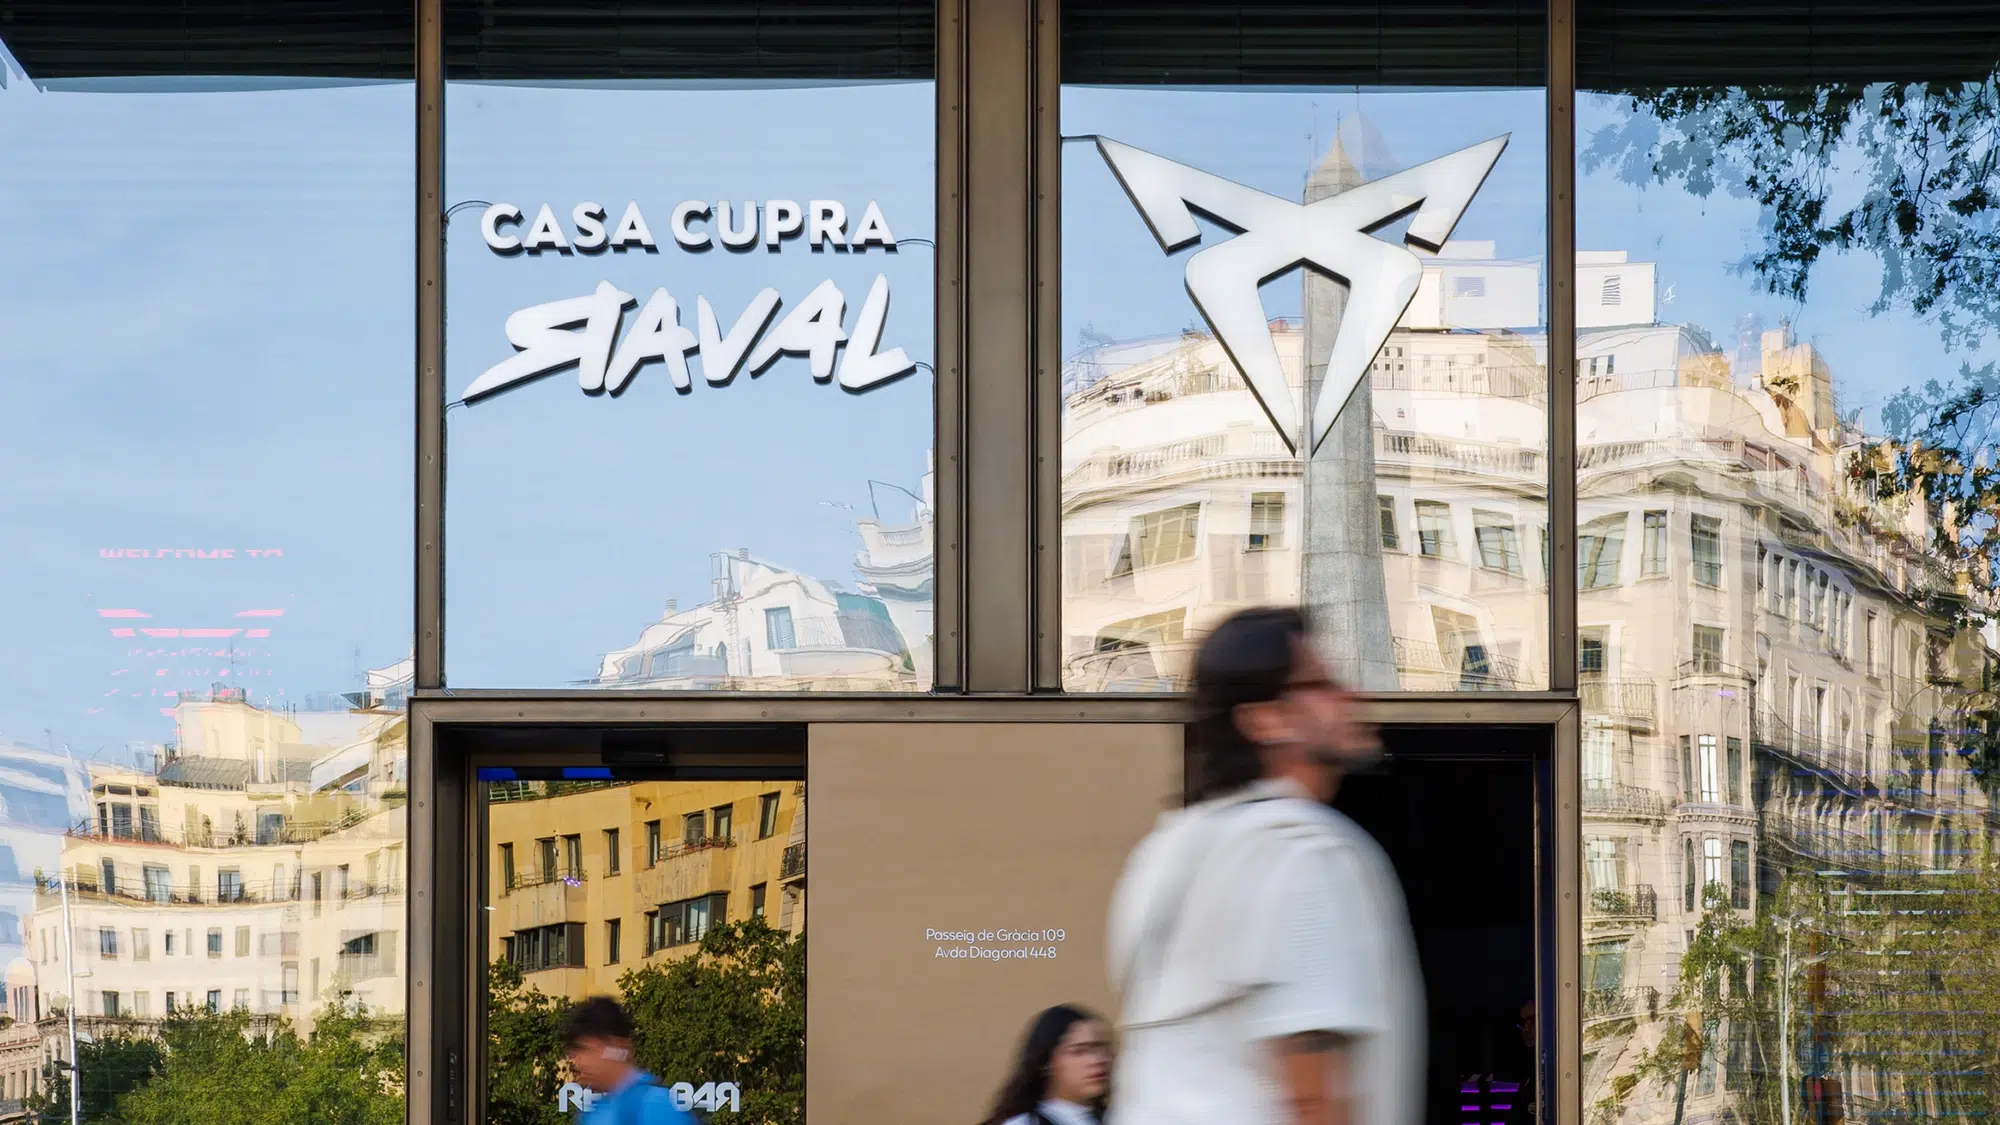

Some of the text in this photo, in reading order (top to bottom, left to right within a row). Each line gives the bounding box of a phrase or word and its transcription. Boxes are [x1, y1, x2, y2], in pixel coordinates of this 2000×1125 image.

[480, 199, 898, 253] CASA CUPRA
[926, 928, 1066, 944] Passeig de Gràcia 109
[935, 946, 1057, 962] Avda Diagonal 448
